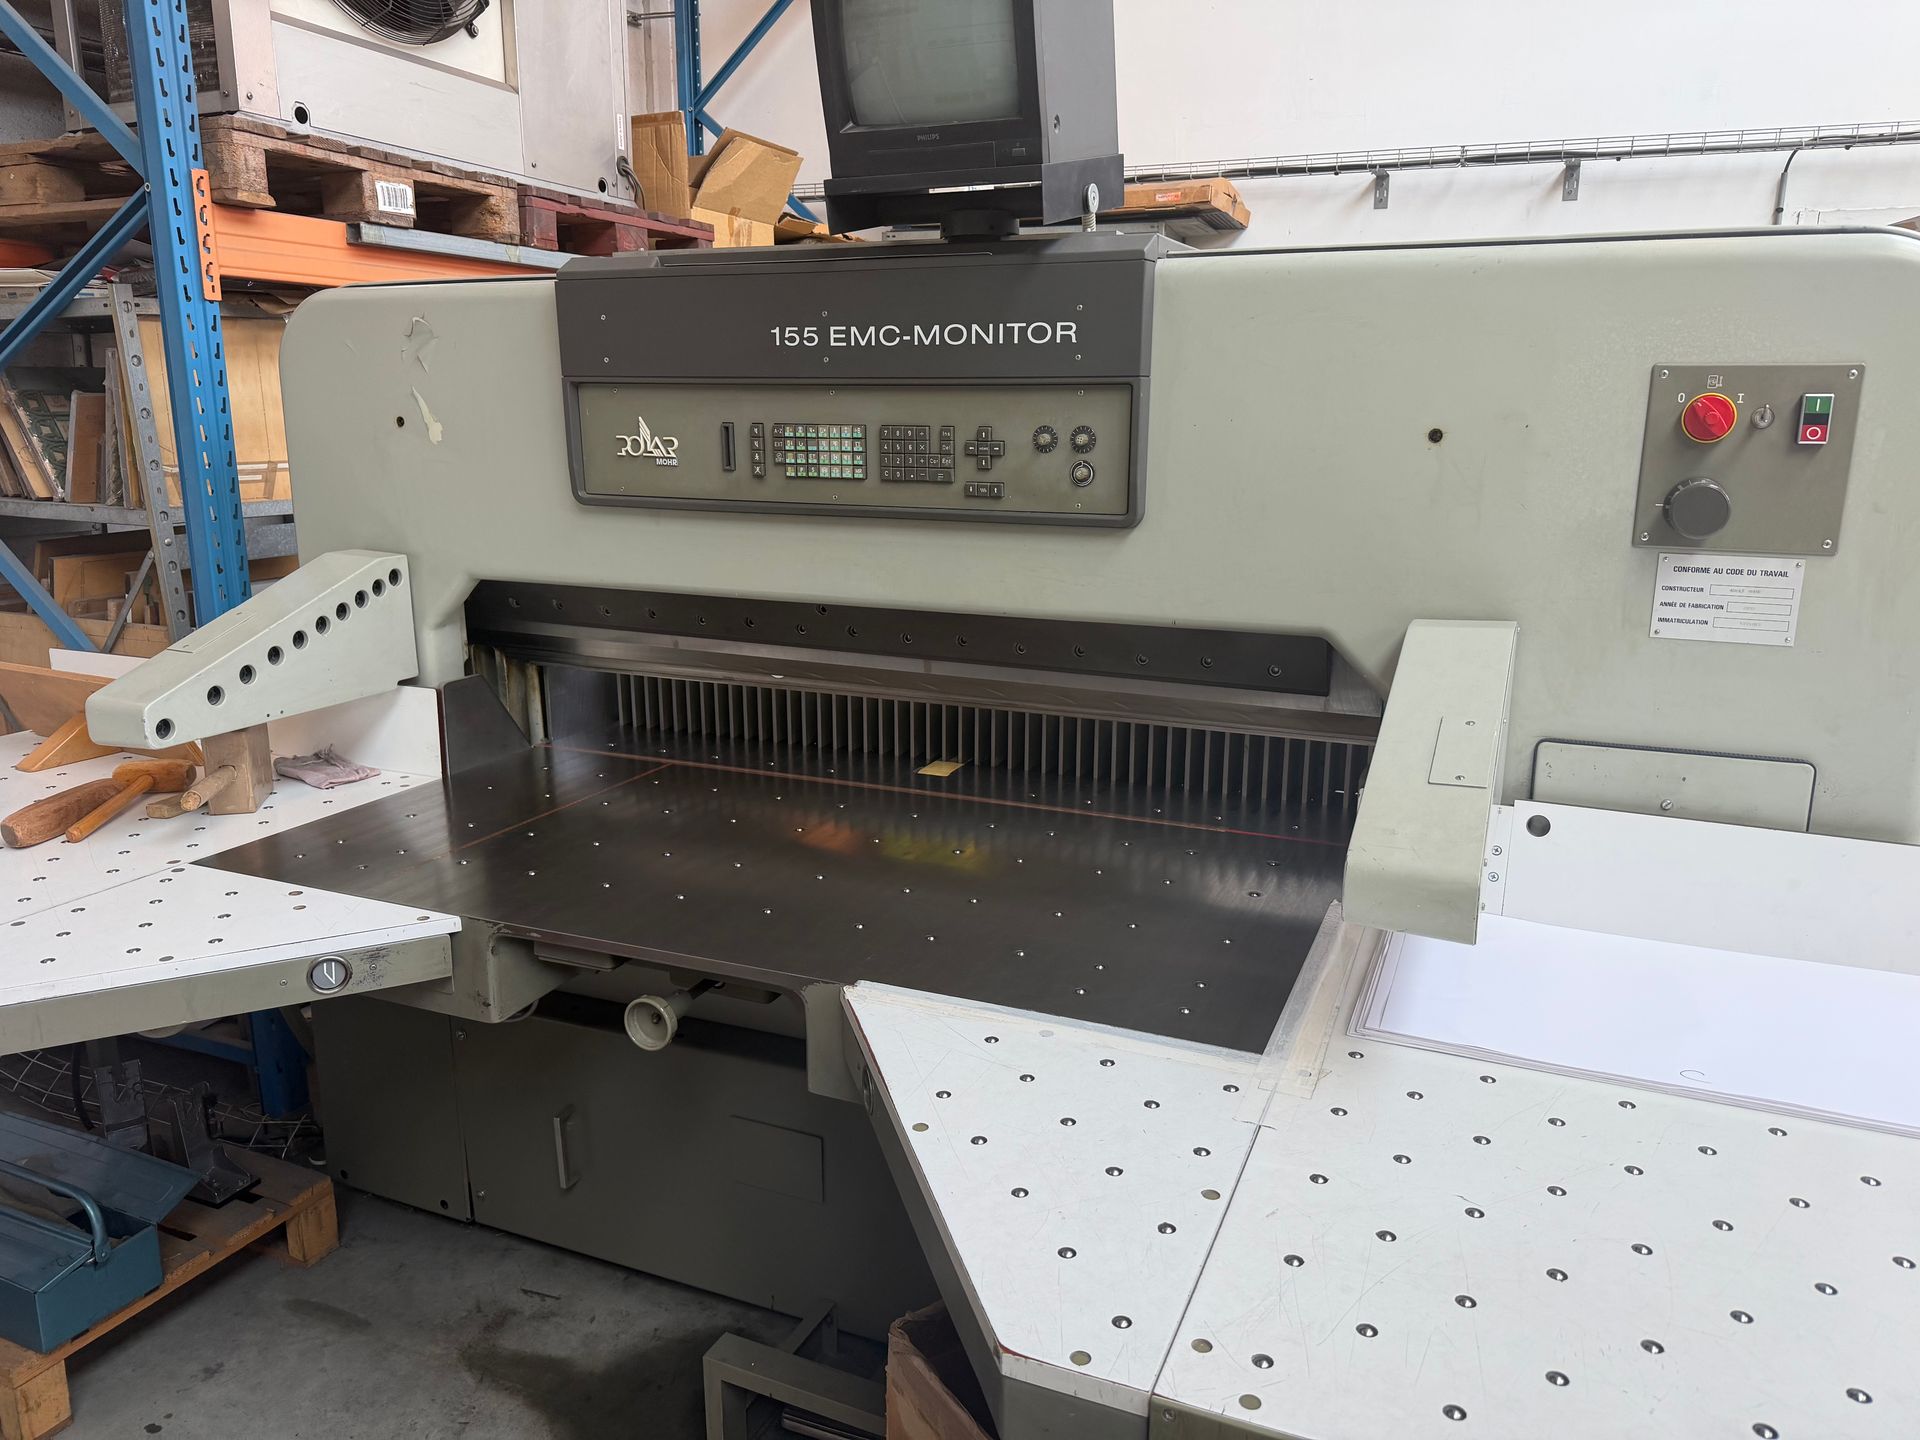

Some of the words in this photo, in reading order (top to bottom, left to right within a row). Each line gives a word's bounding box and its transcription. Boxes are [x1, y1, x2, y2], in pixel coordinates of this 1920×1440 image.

[916, 133, 940, 142] PHILIPS
[770, 326, 819, 346] 155
[830, 321, 1077, 347] EMC-MONITOR
[615, 416, 679, 459] POLAR
[656, 458, 679, 467] MOHR
[1673, 565, 1711, 575] CONFORME
[1713, 567, 1724, 575] AU
[1725, 568, 1745, 576] CODE
[1760, 569, 1789, 578] TRAVAIL
[1661, 585, 1705, 593] CONSTRUCTEUR
[1688, 602, 1724, 610] FABRICATION
[1657, 616, 1709, 626] IMMATRICULATION
